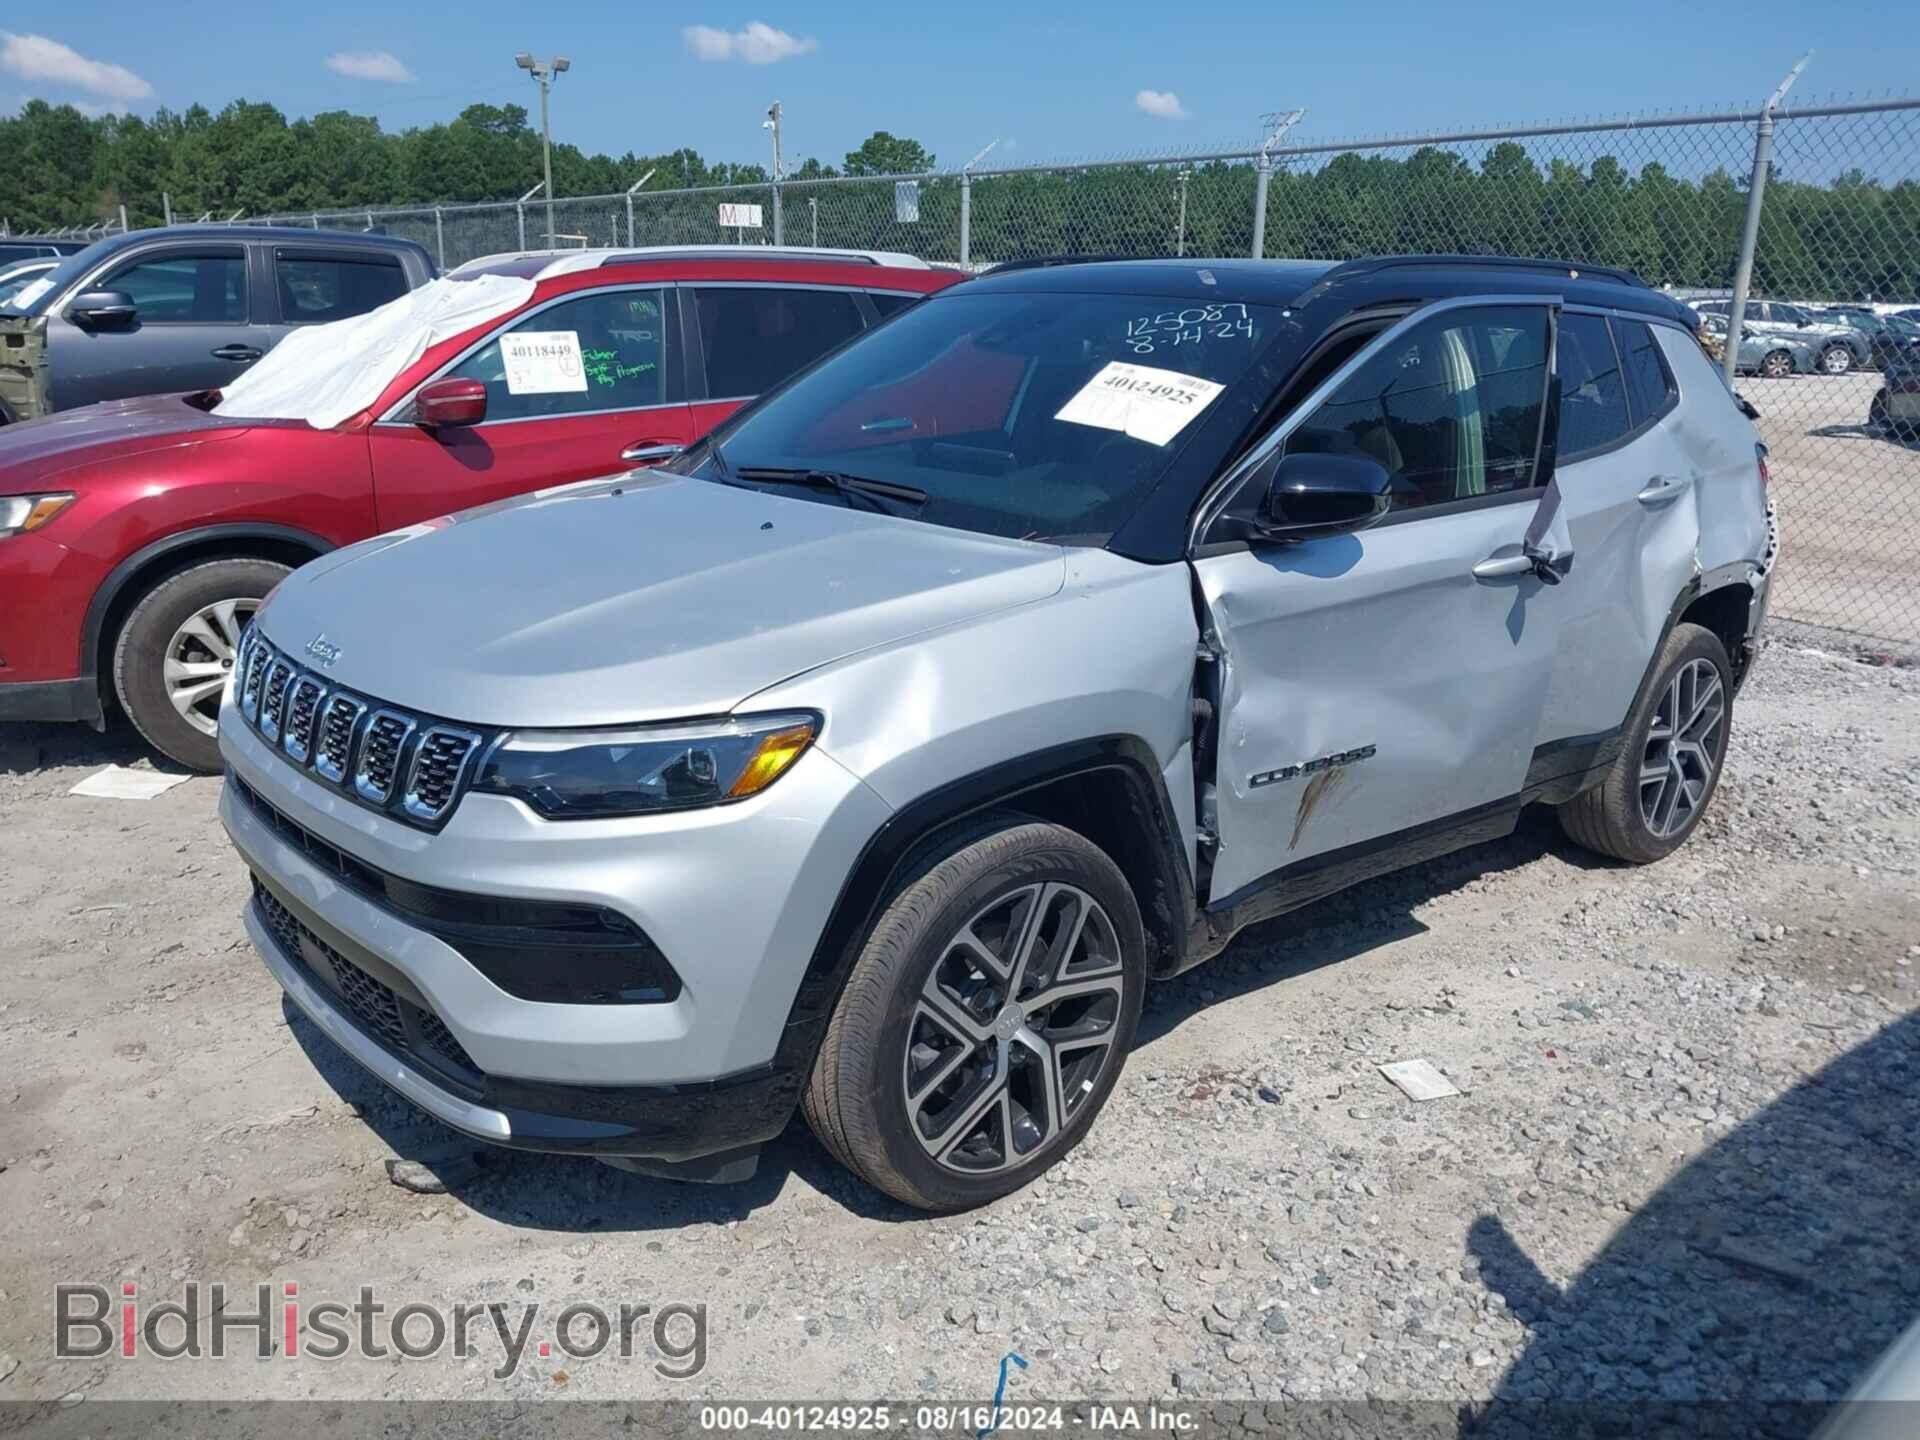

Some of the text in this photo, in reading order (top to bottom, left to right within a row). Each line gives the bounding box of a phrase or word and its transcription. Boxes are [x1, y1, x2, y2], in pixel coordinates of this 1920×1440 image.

[1127, 303, 1247, 337] 125087
[511, 344, 572, 358] 40118449
[1103, 375, 1198, 405] 40124925
[305, 632, 342, 668] Jeep
[1248, 744, 1377, 789] COMPASS
